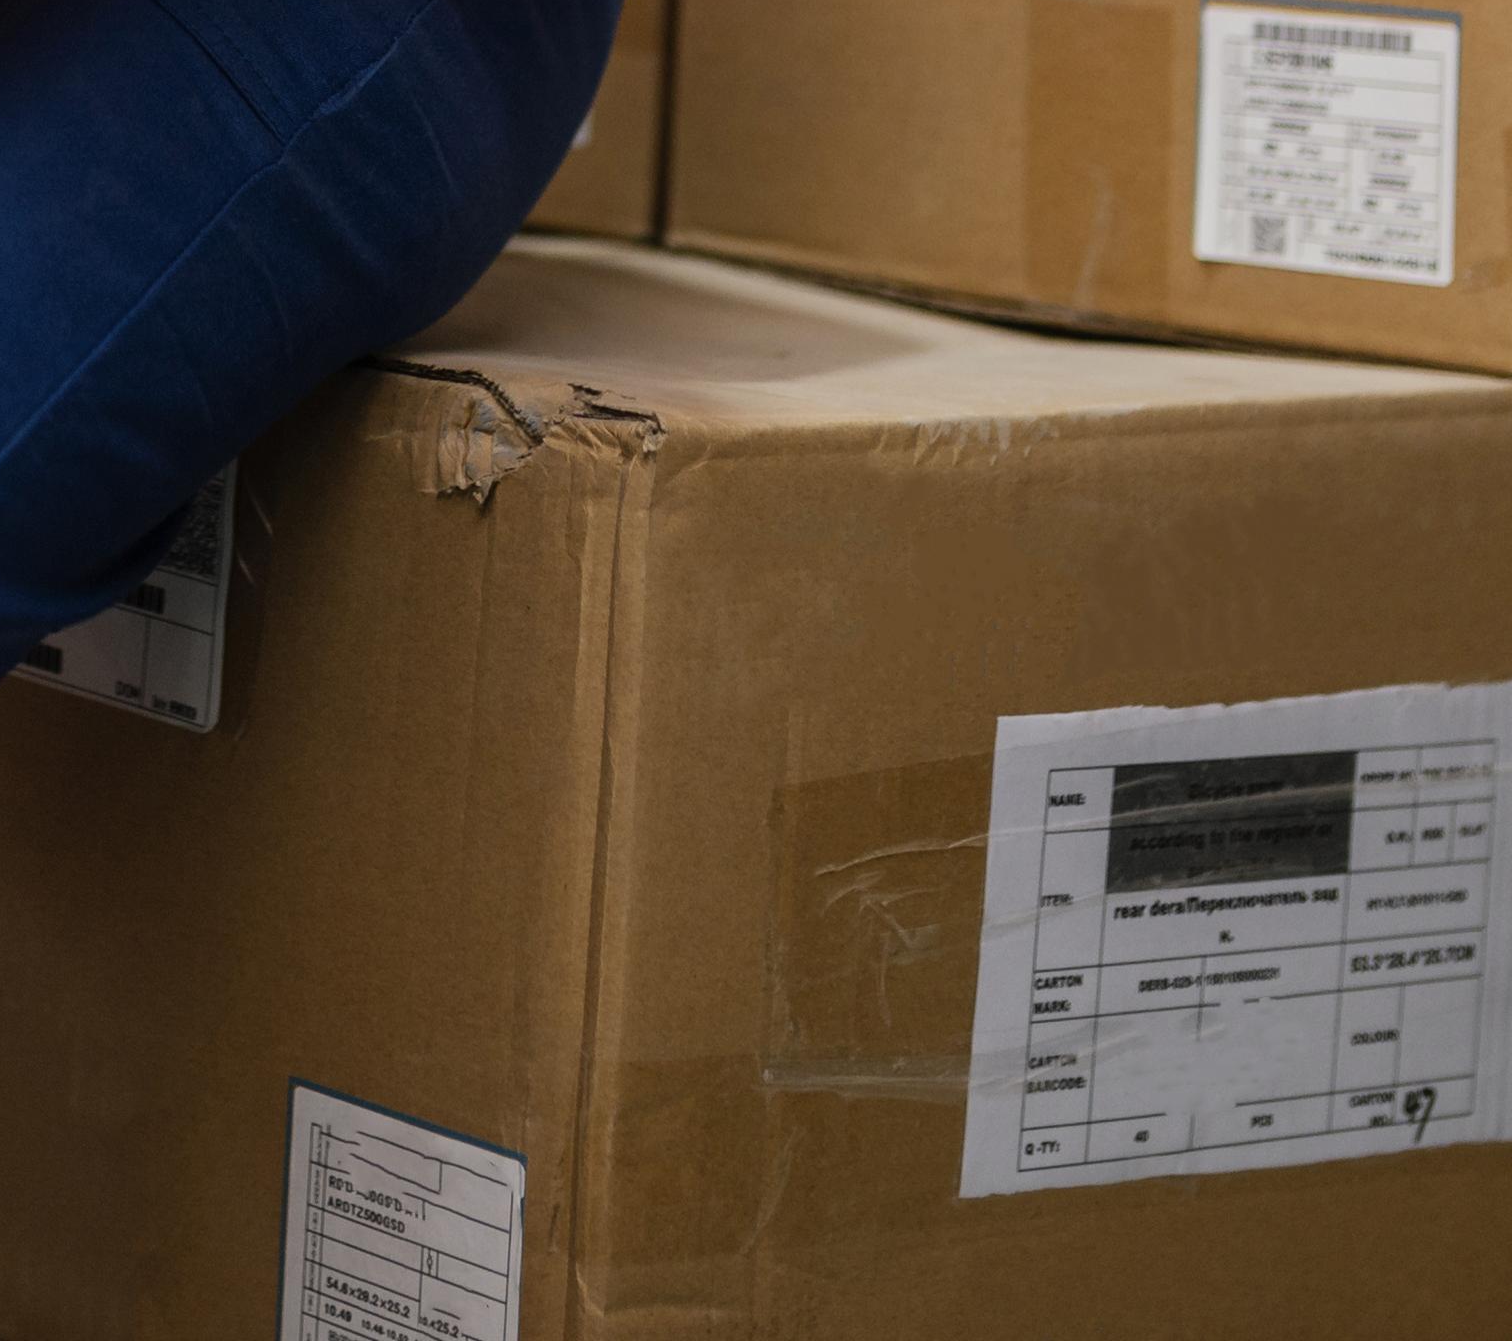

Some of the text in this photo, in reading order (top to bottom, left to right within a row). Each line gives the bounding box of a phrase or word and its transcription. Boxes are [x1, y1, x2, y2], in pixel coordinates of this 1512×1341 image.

[1048, 793, 1086, 807] NAME:
[1113, 905, 1146, 920] rear
[1034, 975, 1084, 990] CARTON
[1028, 1054, 1078, 1070] CARTON
[1025, 1076, 1088, 1094] BARCODE:
